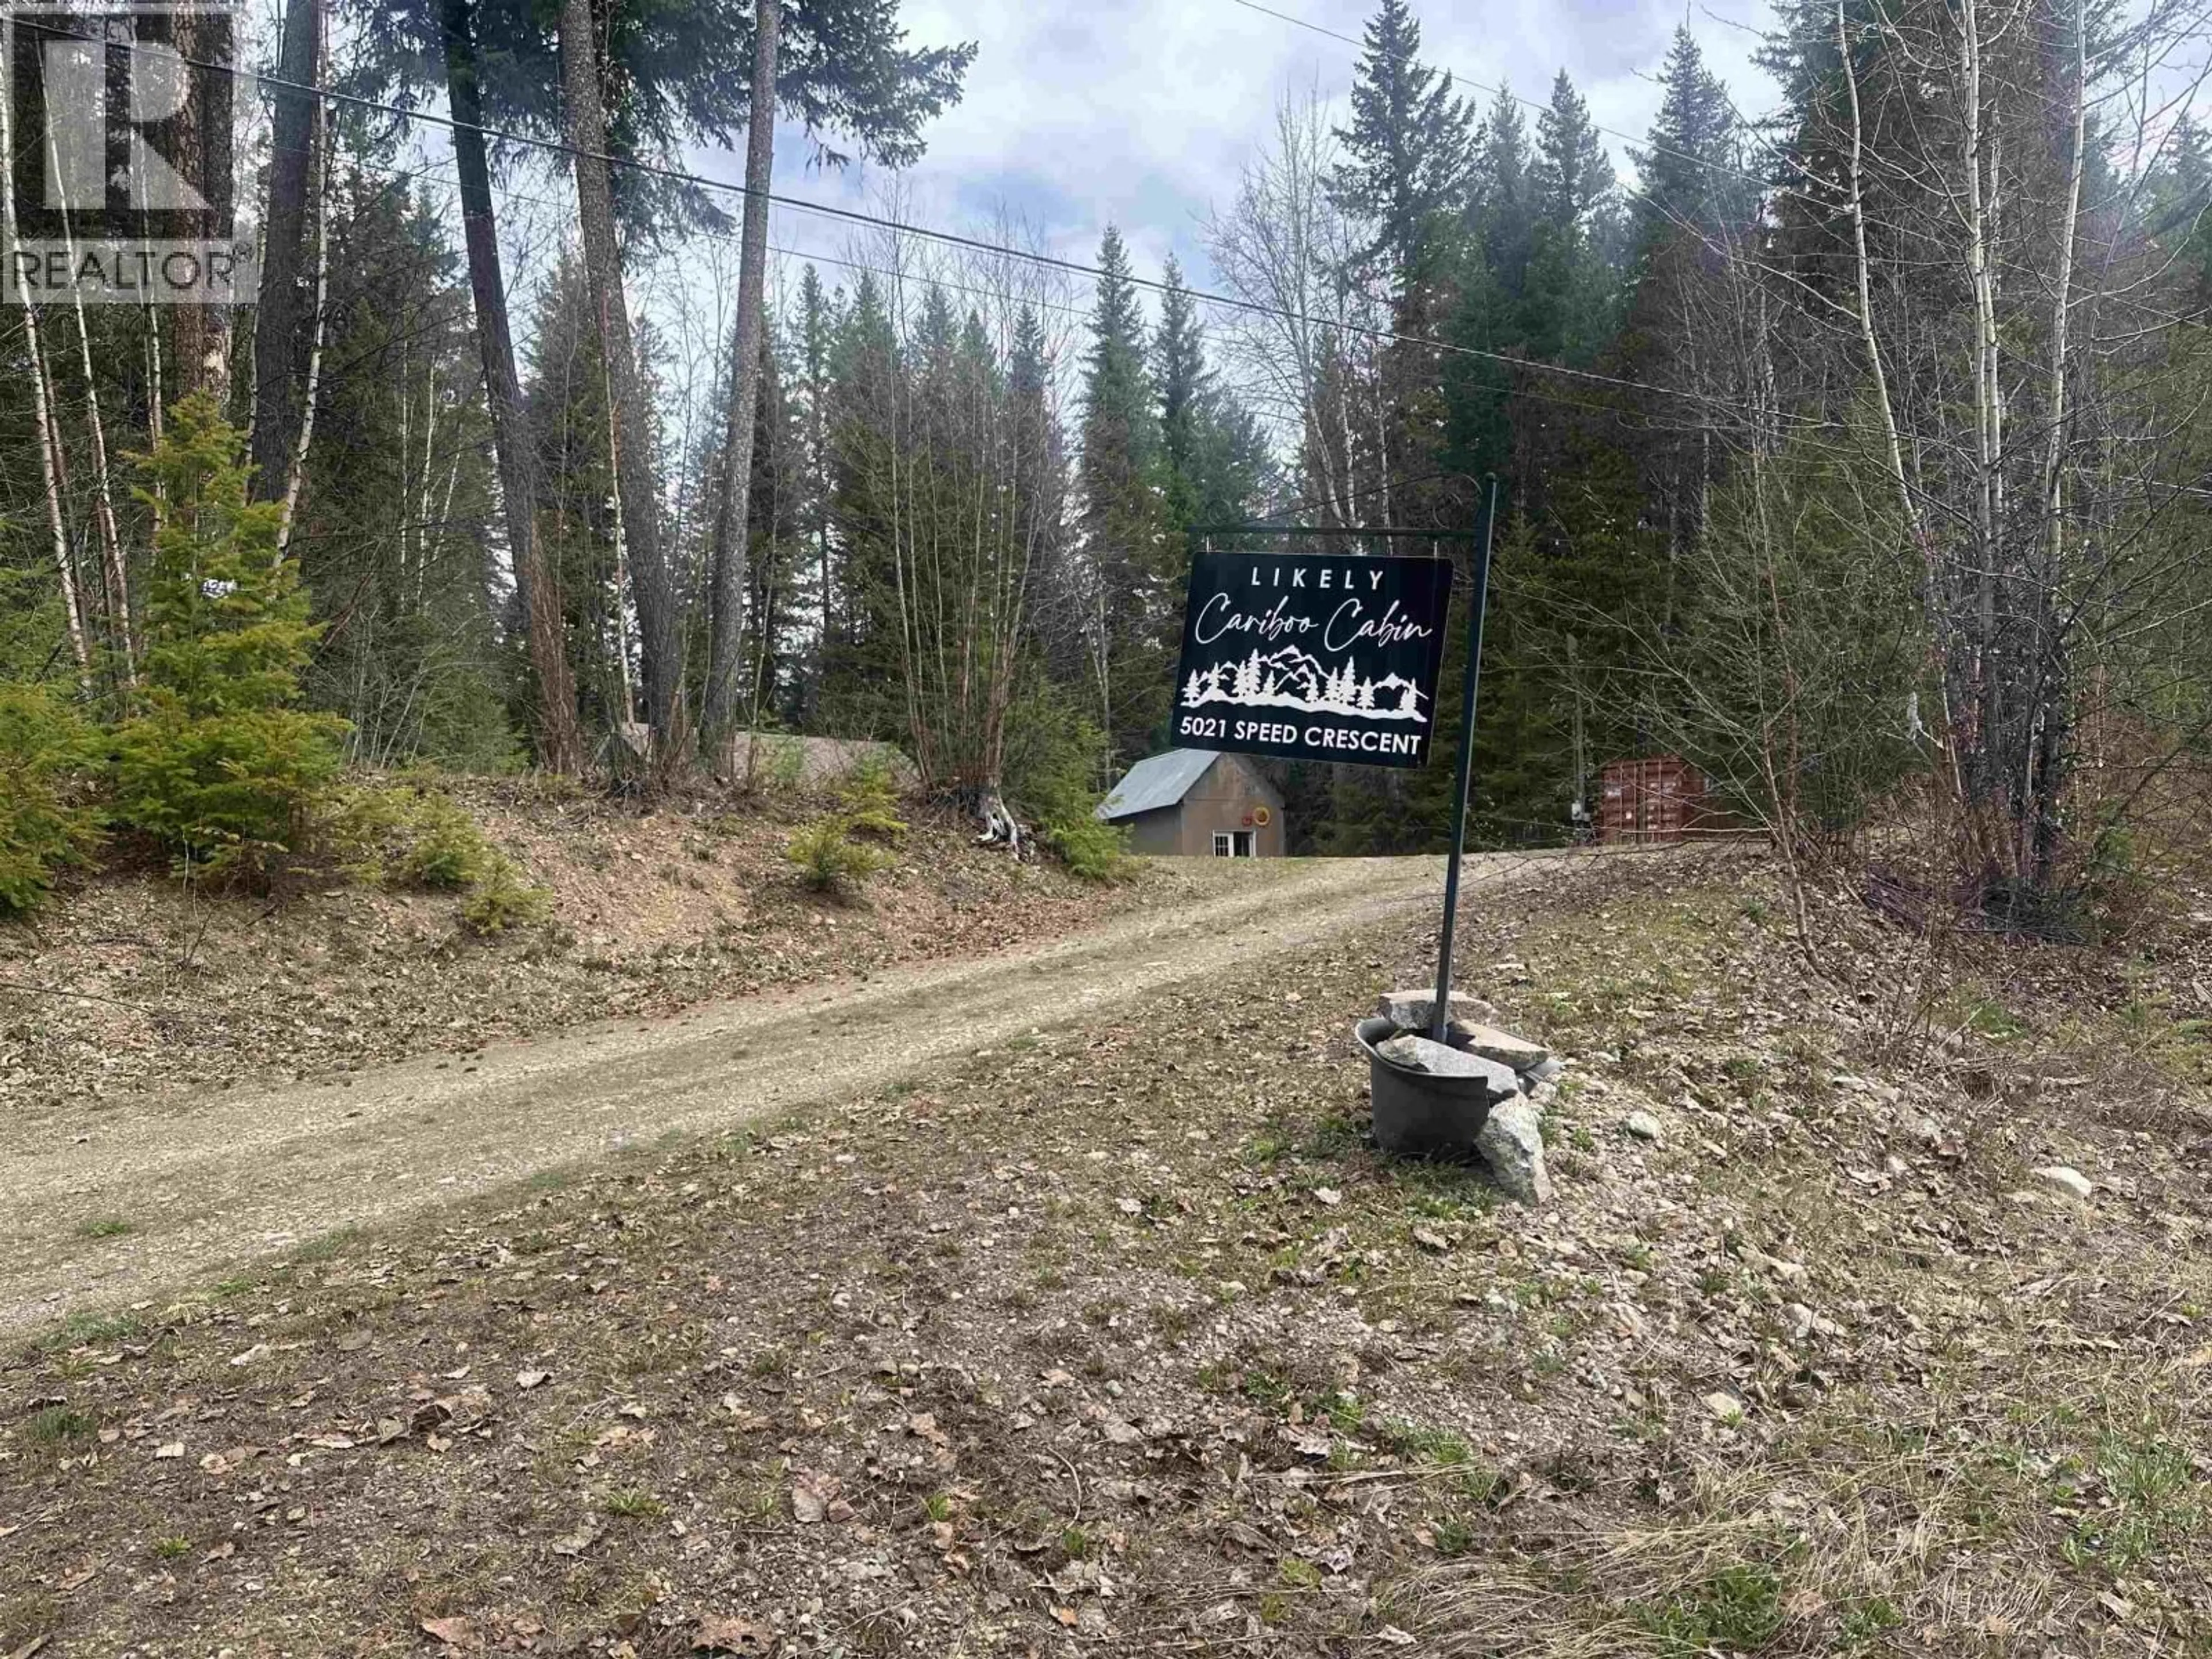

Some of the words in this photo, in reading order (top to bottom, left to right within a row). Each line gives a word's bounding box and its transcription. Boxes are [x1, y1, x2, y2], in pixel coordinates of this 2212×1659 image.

[1251, 567, 1383, 590] LIKELY
[1195, 592, 1319, 644] Cariboo
[1324, 598, 1433, 652] Cabin
[1179, 716, 1226, 738] 5021
[1234, 720, 1298, 744] SPEED
[1304, 726, 1422, 755] CRESCENT
